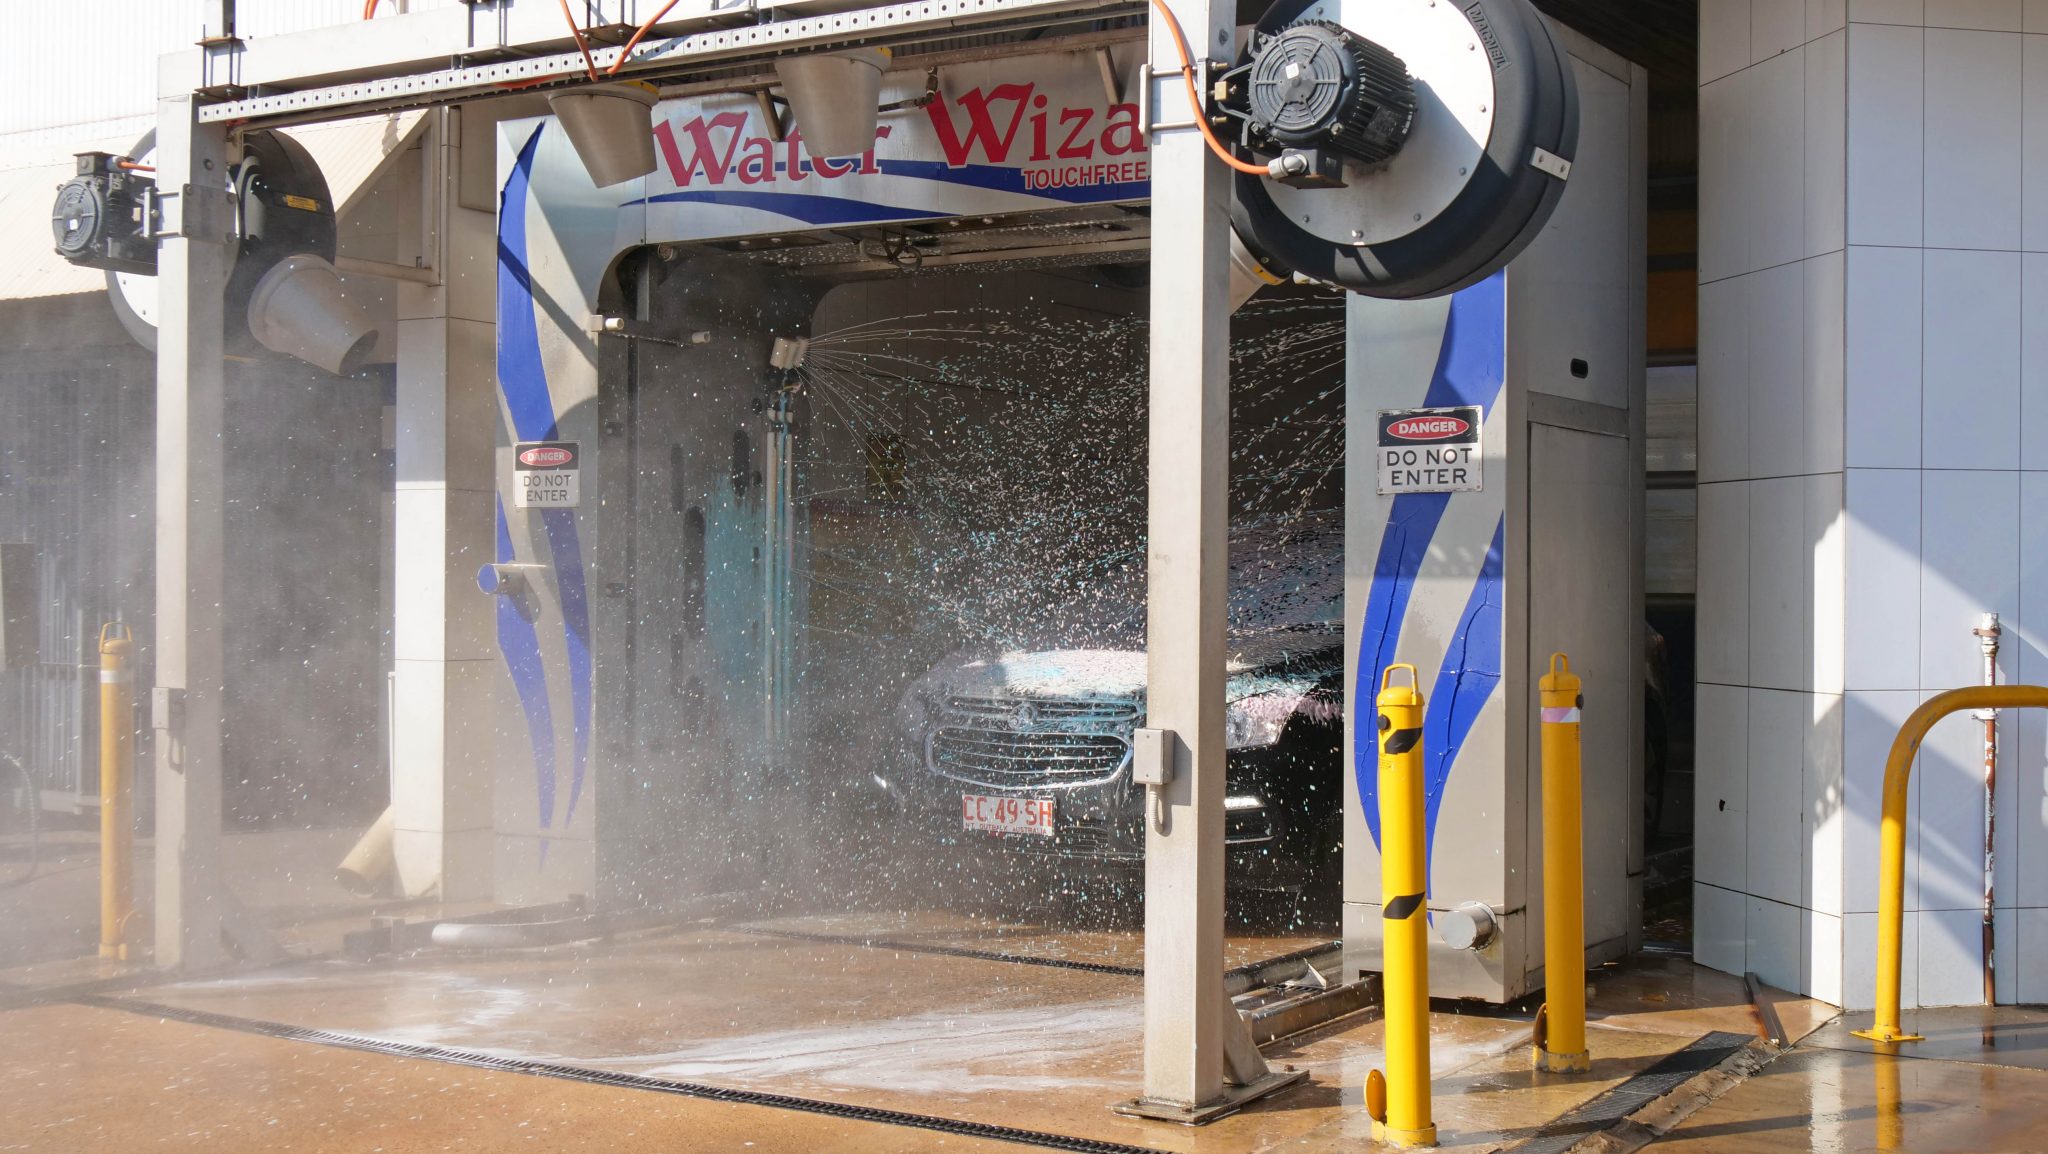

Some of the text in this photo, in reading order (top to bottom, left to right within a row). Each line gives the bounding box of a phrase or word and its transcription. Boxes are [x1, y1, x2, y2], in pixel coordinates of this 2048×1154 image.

[1024, 161, 1147, 190] TOUCHFREE
[1398, 421, 1458, 435] DANGER
[527, 451, 565, 462] DANGER
[1386, 447, 1473, 467] DO NOT
[523, 474, 572, 487] DO NOT
[1391, 468, 1467, 486] ENTER
[526, 489, 568, 502] ENTER
